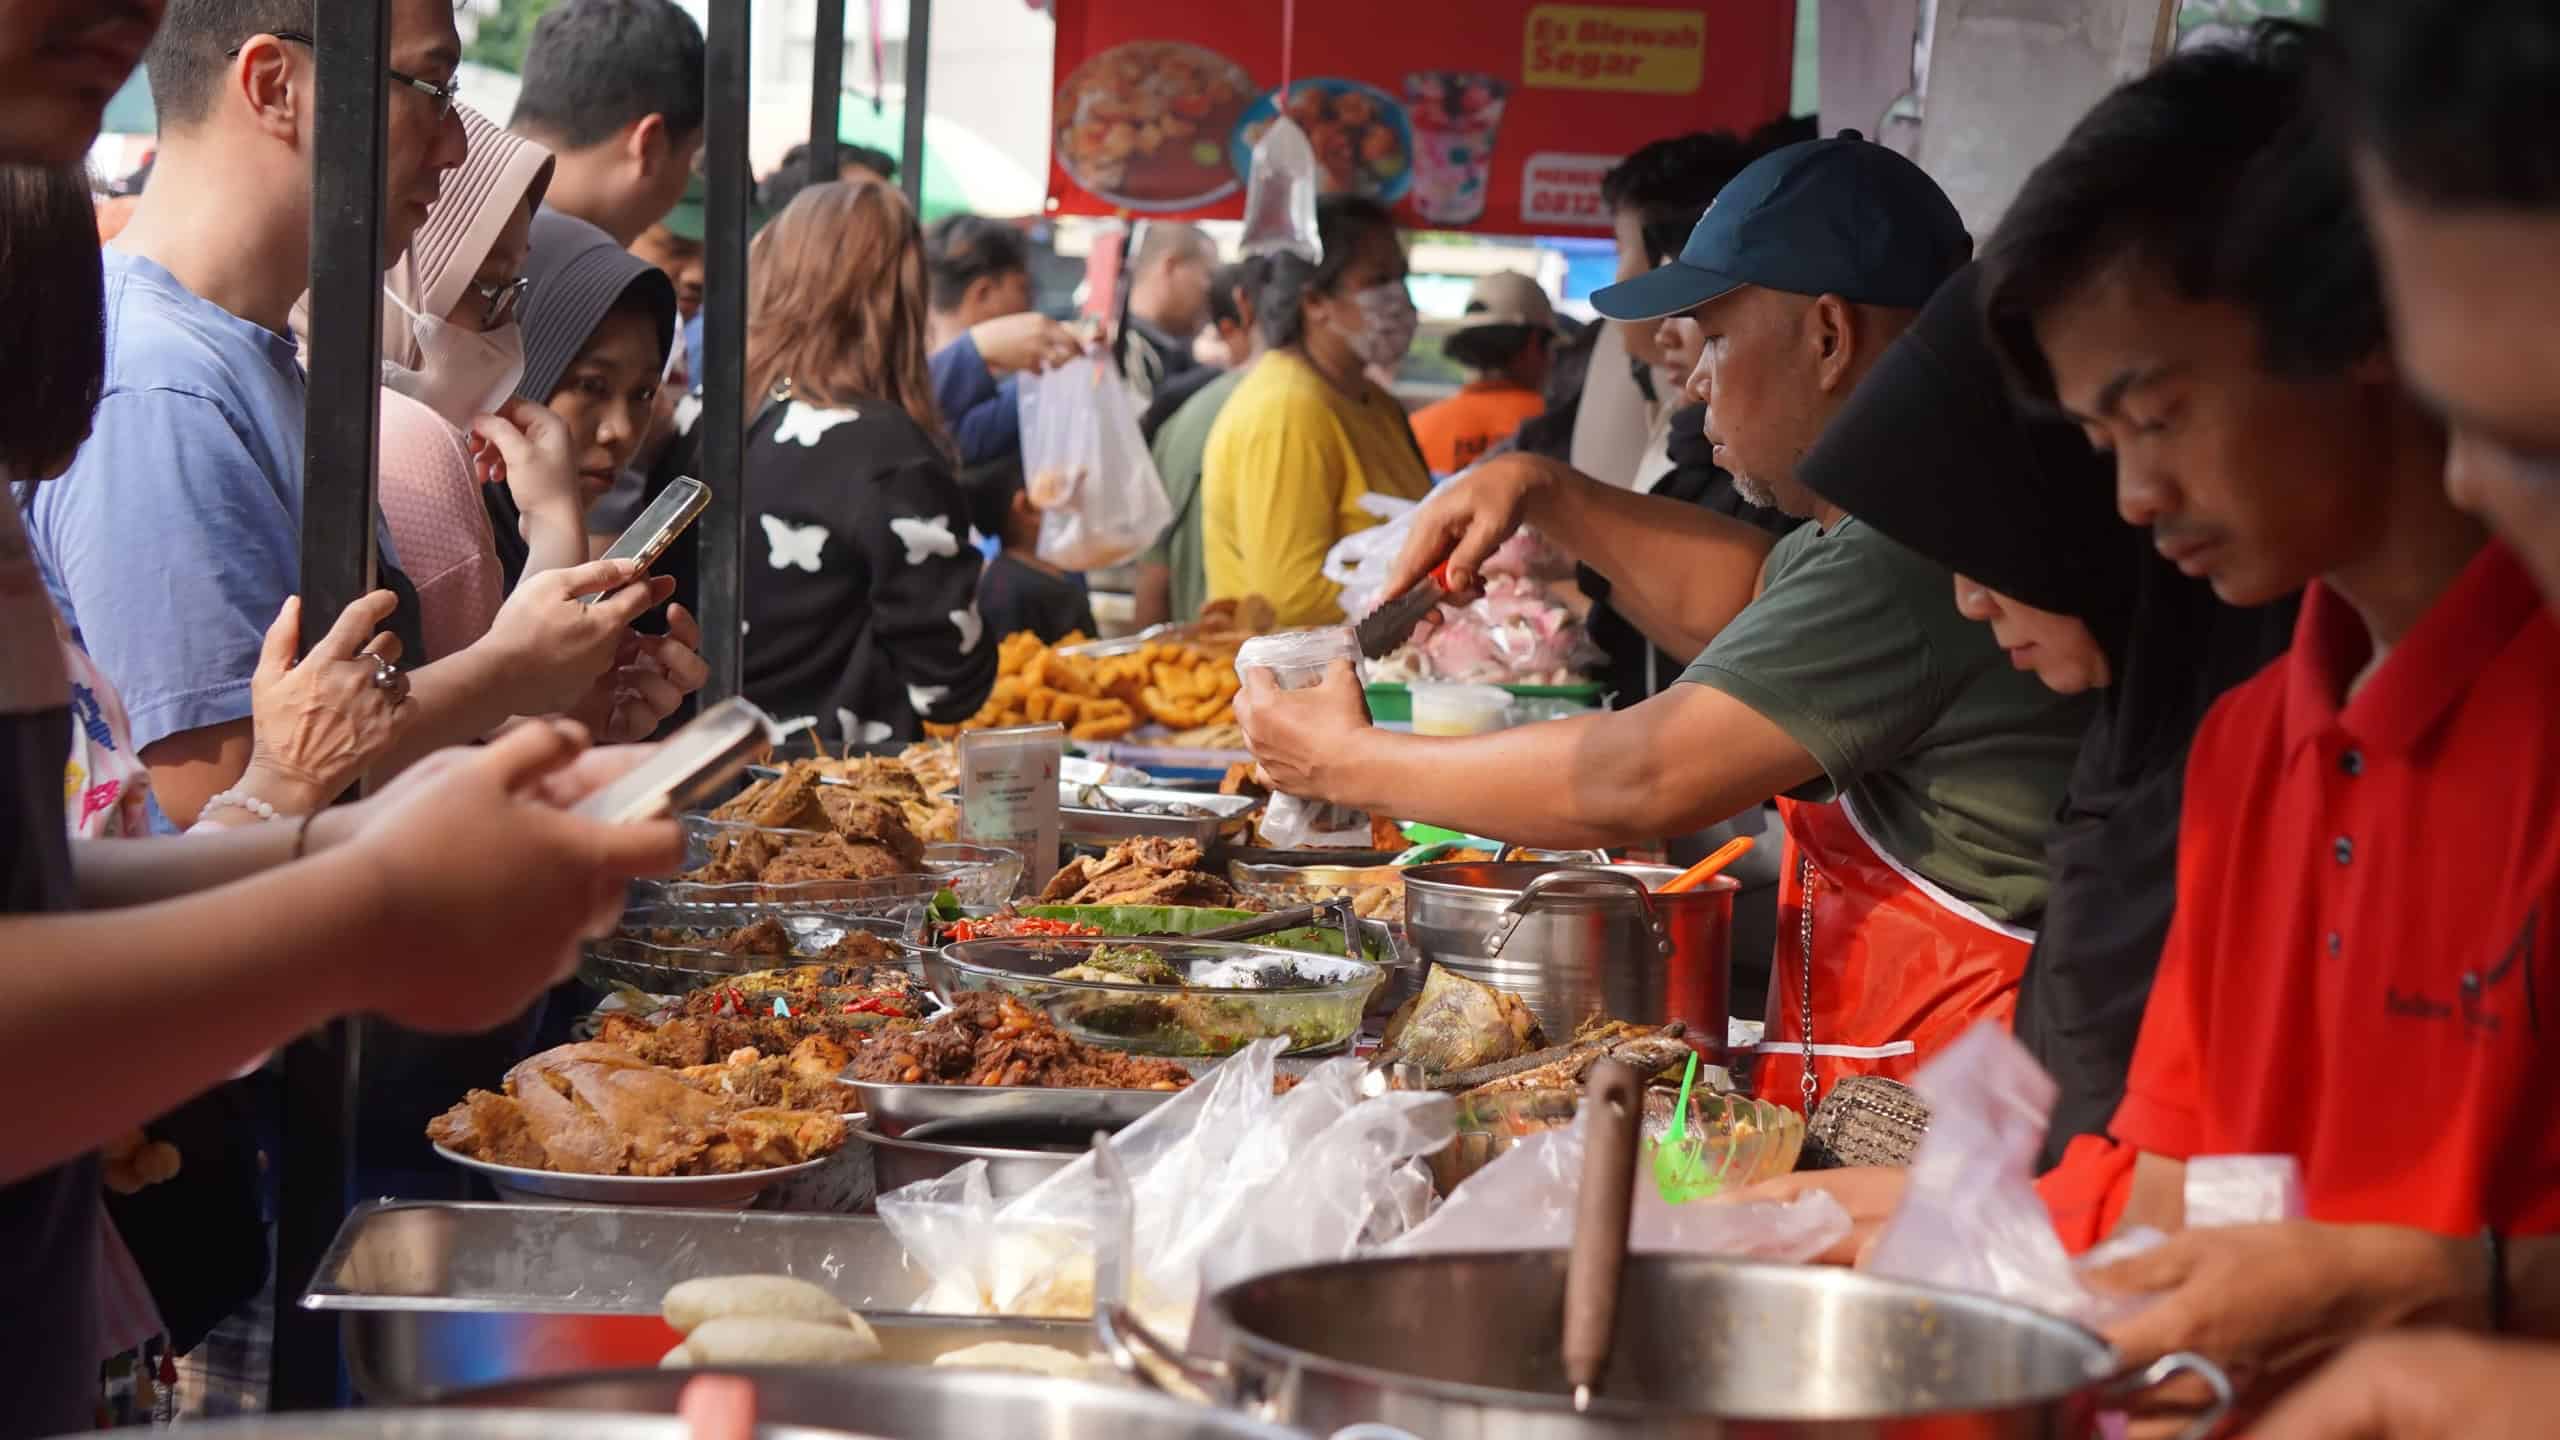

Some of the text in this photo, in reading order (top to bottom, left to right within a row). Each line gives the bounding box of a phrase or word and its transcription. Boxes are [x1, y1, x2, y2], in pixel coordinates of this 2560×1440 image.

[1533, 17, 1700, 47] Es Blewah
[1531, 46, 1644, 78] Segar
